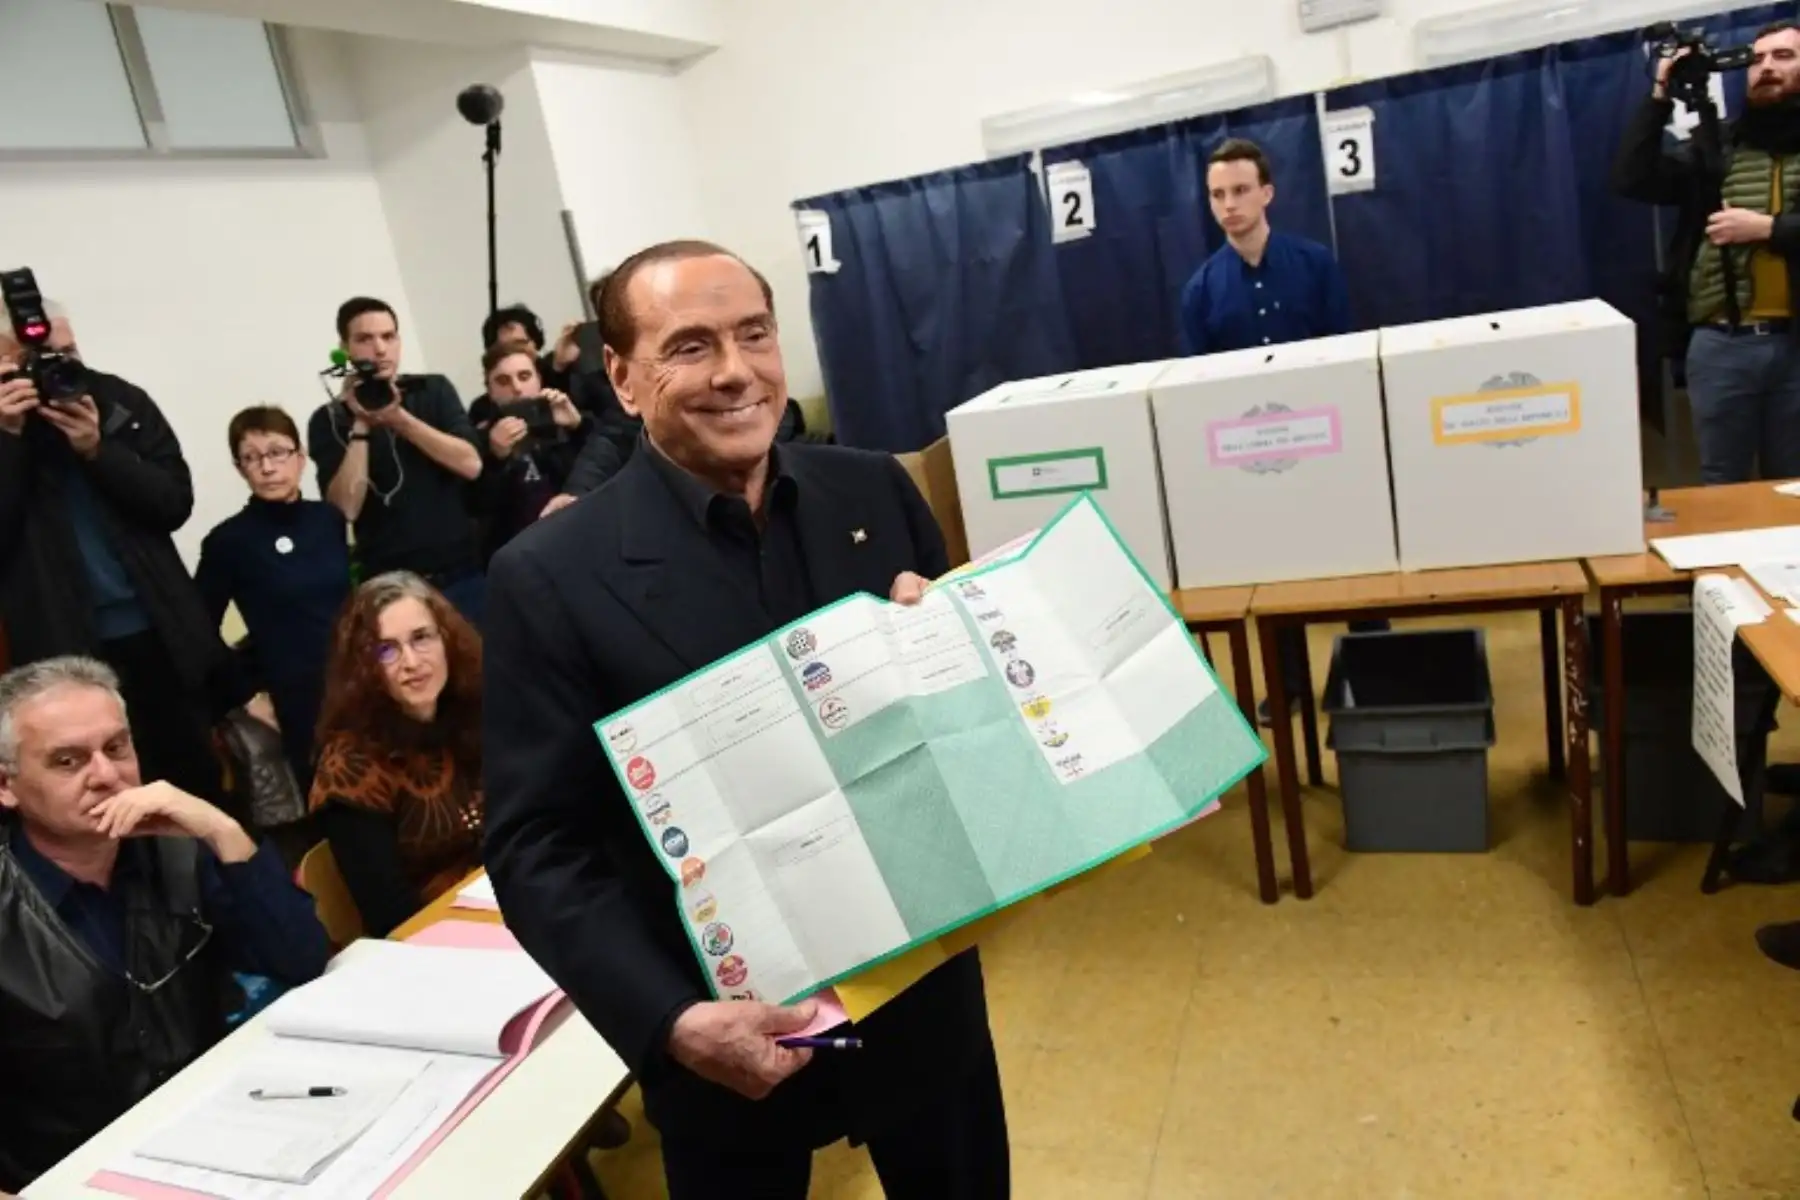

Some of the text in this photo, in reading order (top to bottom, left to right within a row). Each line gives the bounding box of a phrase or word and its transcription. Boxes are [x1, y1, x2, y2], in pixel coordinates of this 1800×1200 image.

[1340, 139, 1361, 177] 3
[1063, 191, 1083, 227] 2
[808, 234, 821, 267] 1
